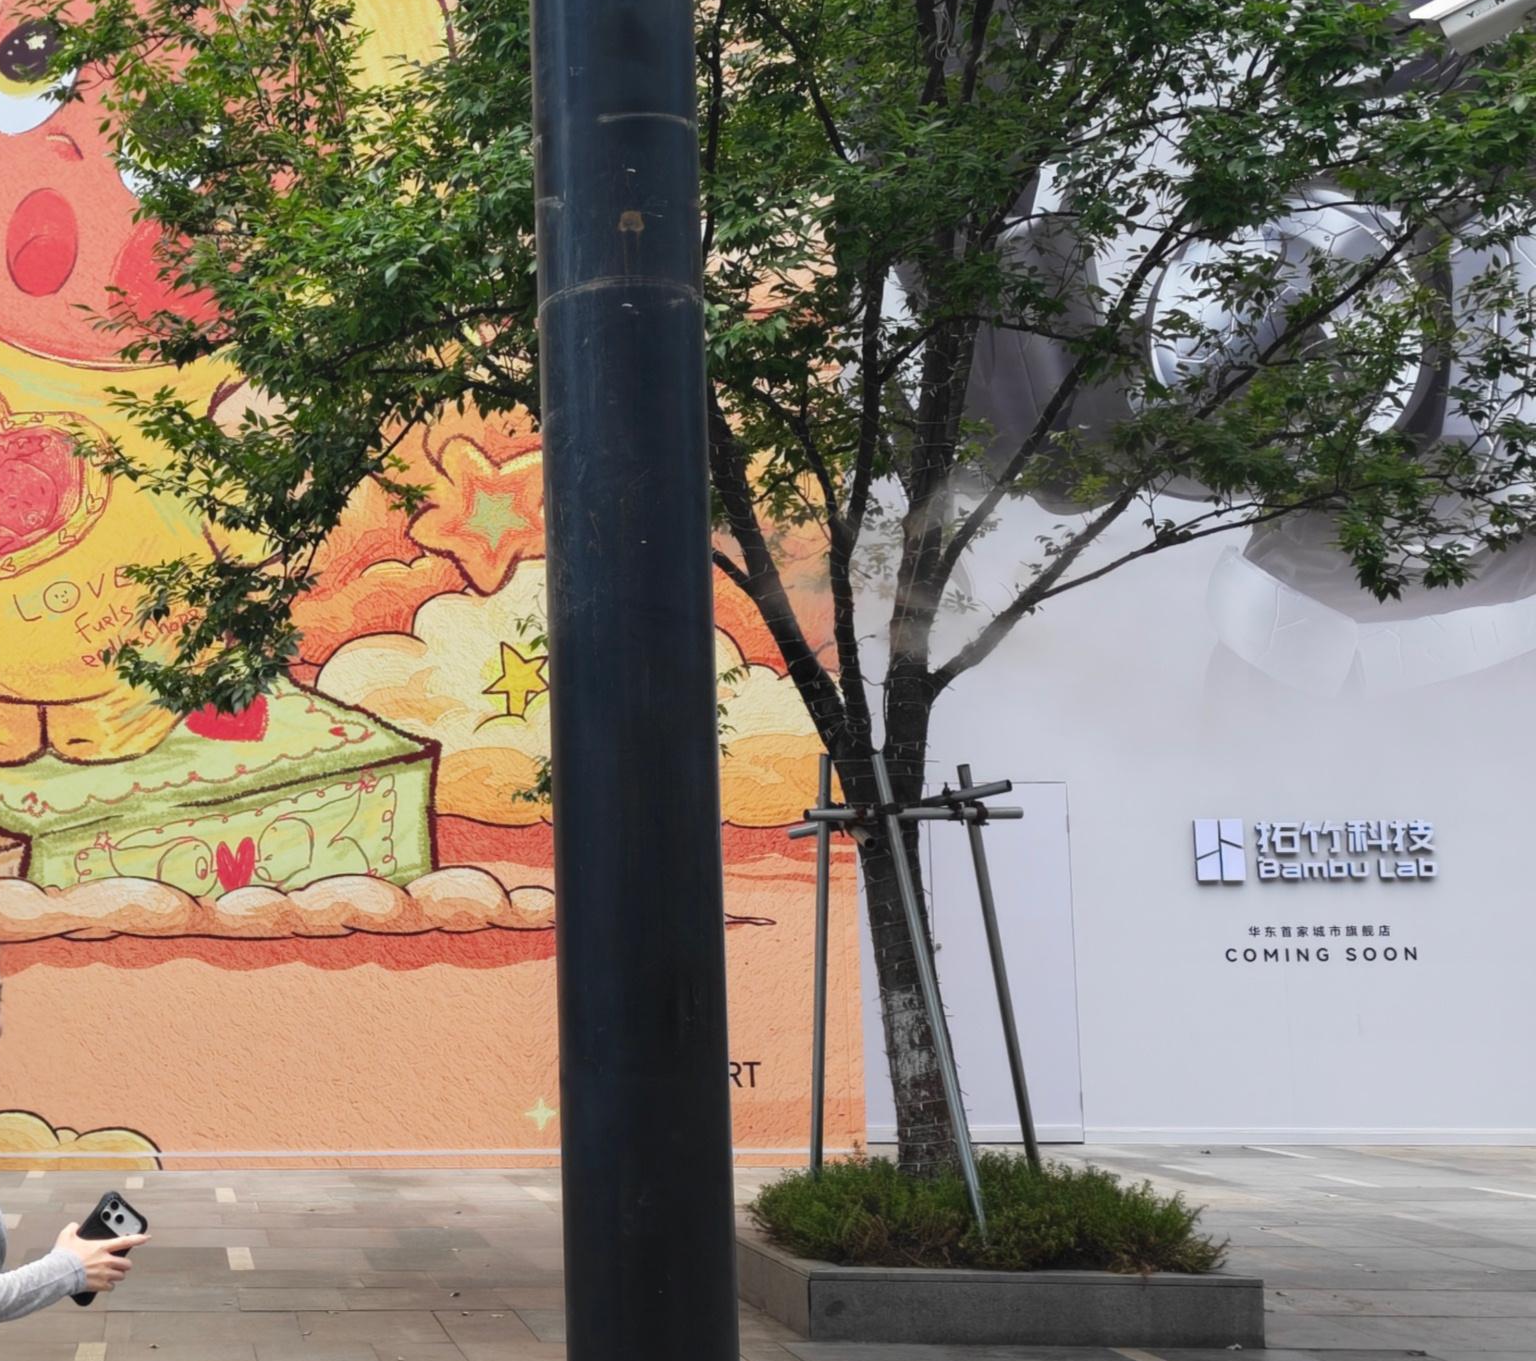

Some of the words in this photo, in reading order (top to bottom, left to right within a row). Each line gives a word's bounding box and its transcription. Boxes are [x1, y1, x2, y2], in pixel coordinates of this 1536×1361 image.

[1255, 819, 1437, 854] 拓竹科技
[1257, 857, 1370, 881] Bambu
[1377, 857, 1439, 880] Lab
[1248, 924, 1391, 938] 华东首家城市旗舰店
[1225, 947, 1330, 963] COMING
[1345, 946, 1419, 962] SOON
